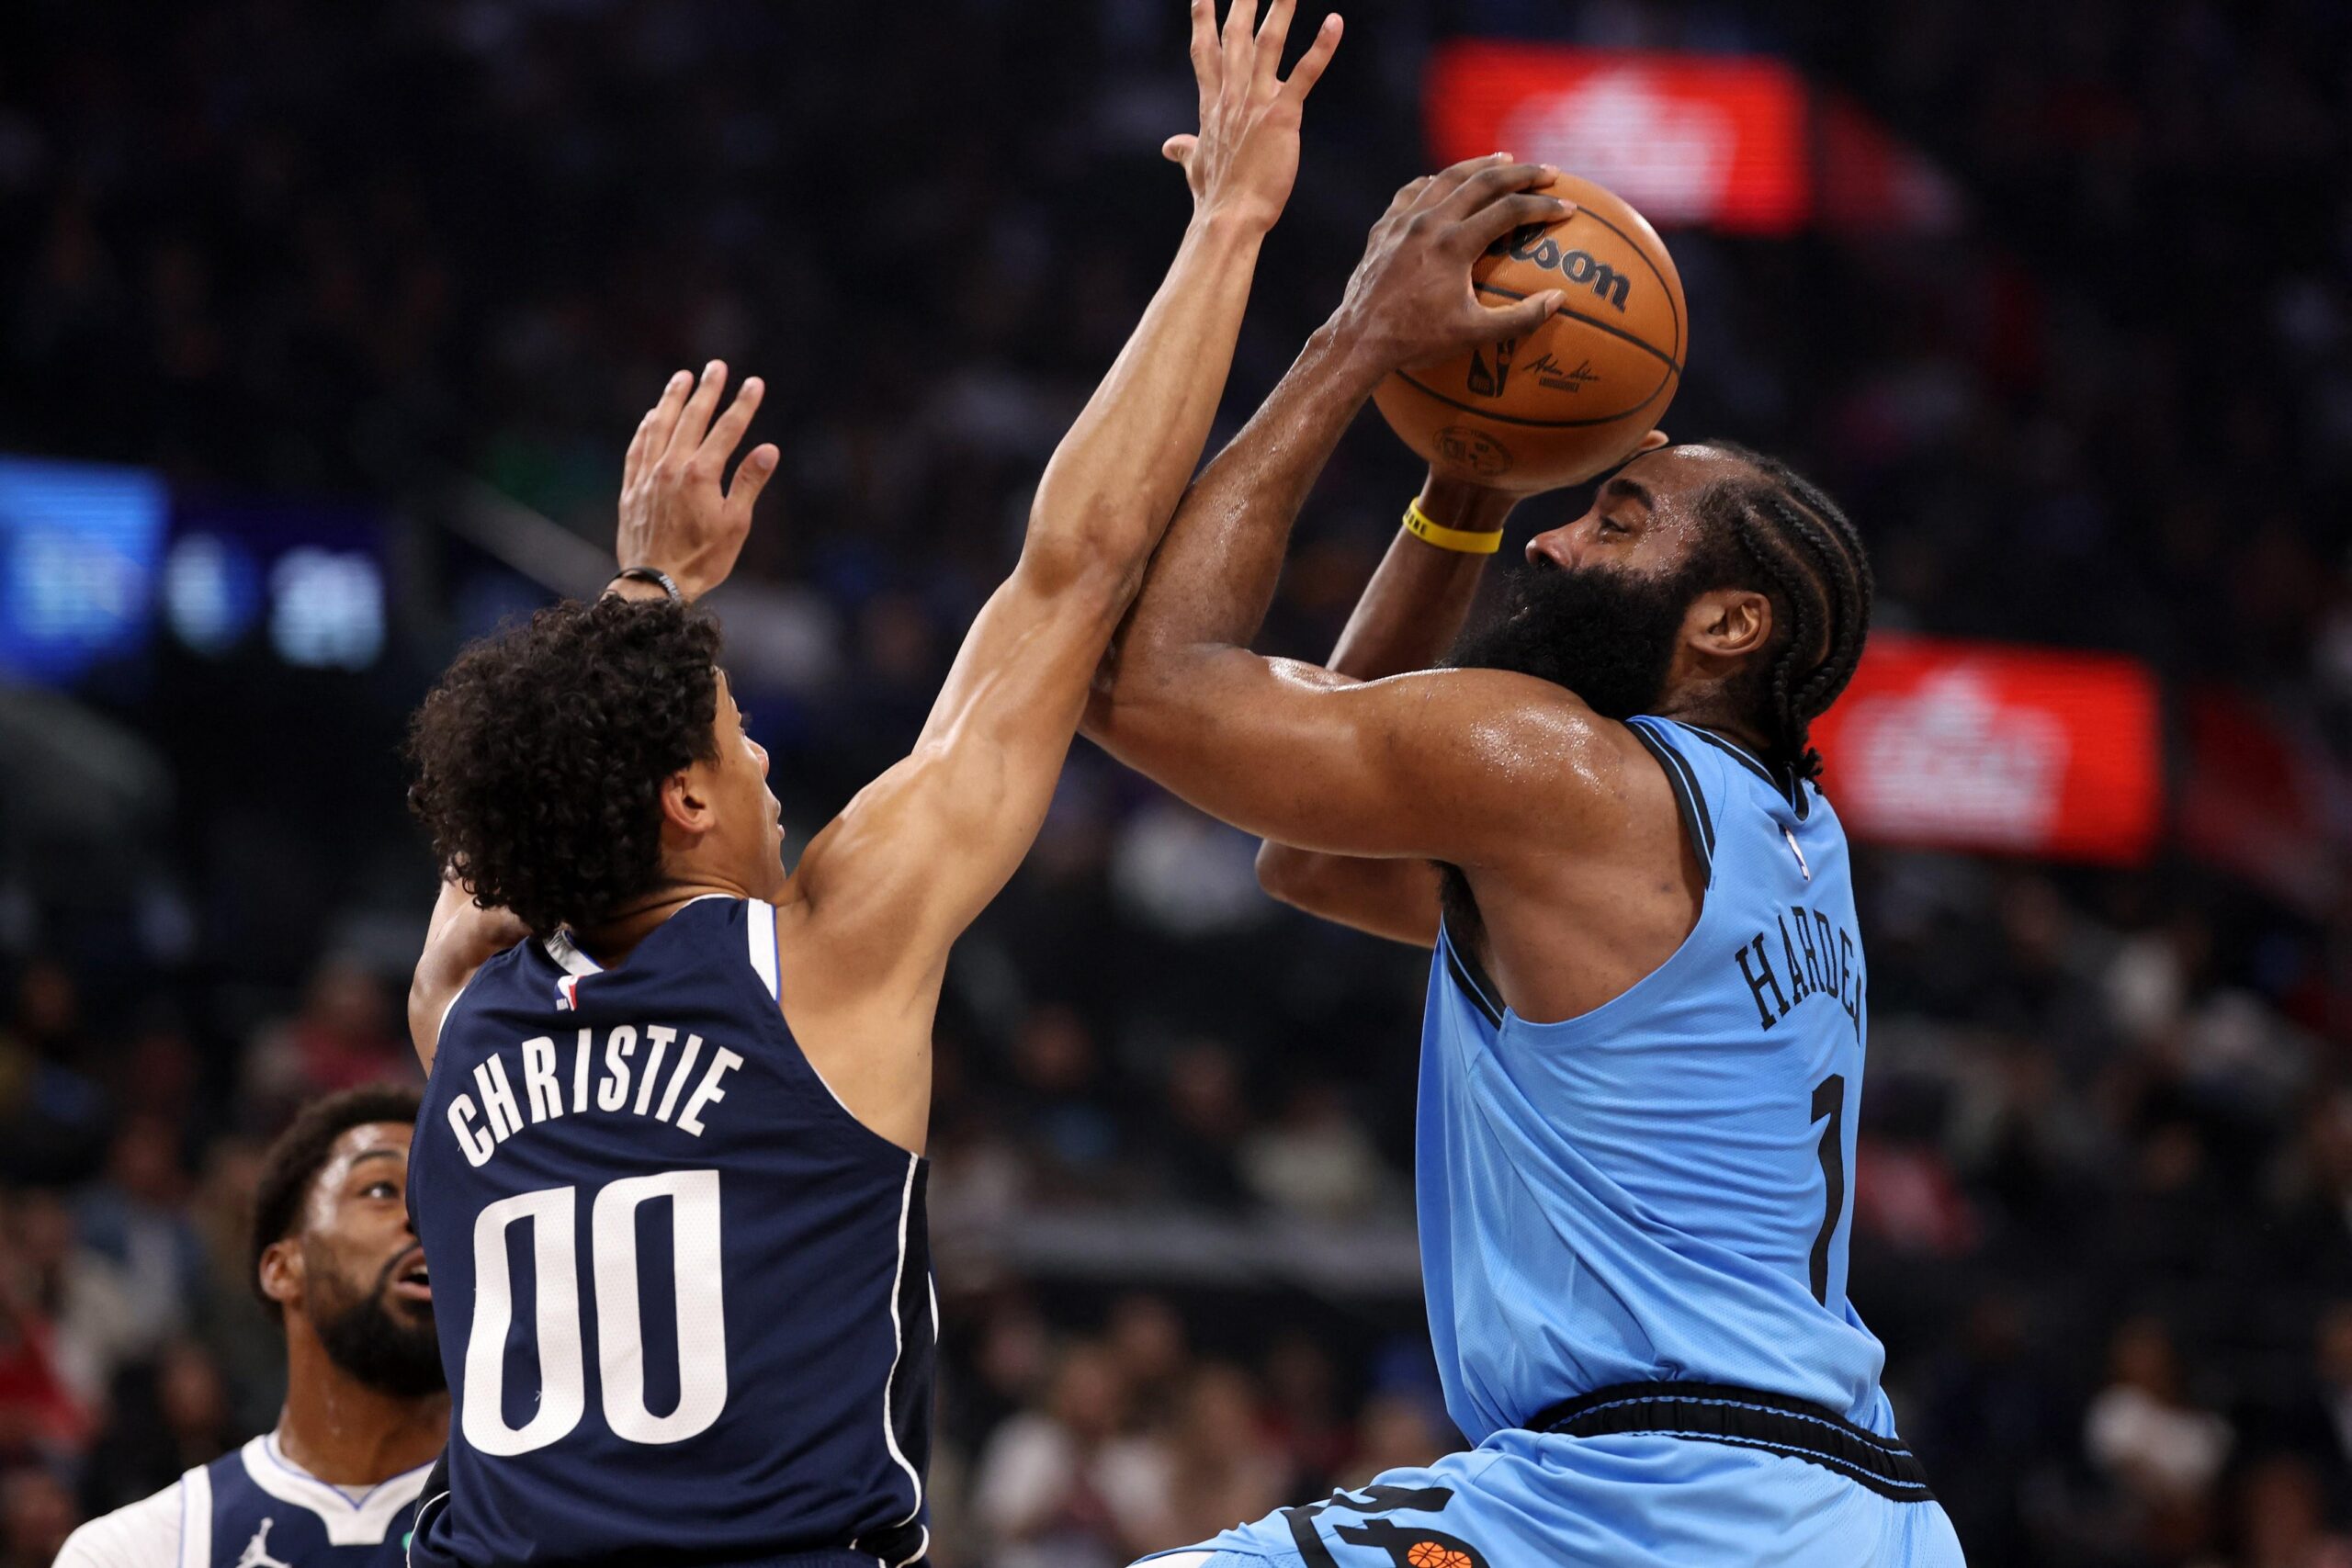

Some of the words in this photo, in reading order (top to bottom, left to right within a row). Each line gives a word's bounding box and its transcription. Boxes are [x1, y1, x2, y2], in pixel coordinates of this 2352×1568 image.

[1485, 220, 1631, 314] lson
[447, 1024, 744, 1168] CHRISTIE
[1809, 1074, 1844, 1308] 1
[462, 1169, 729, 1457] 00
